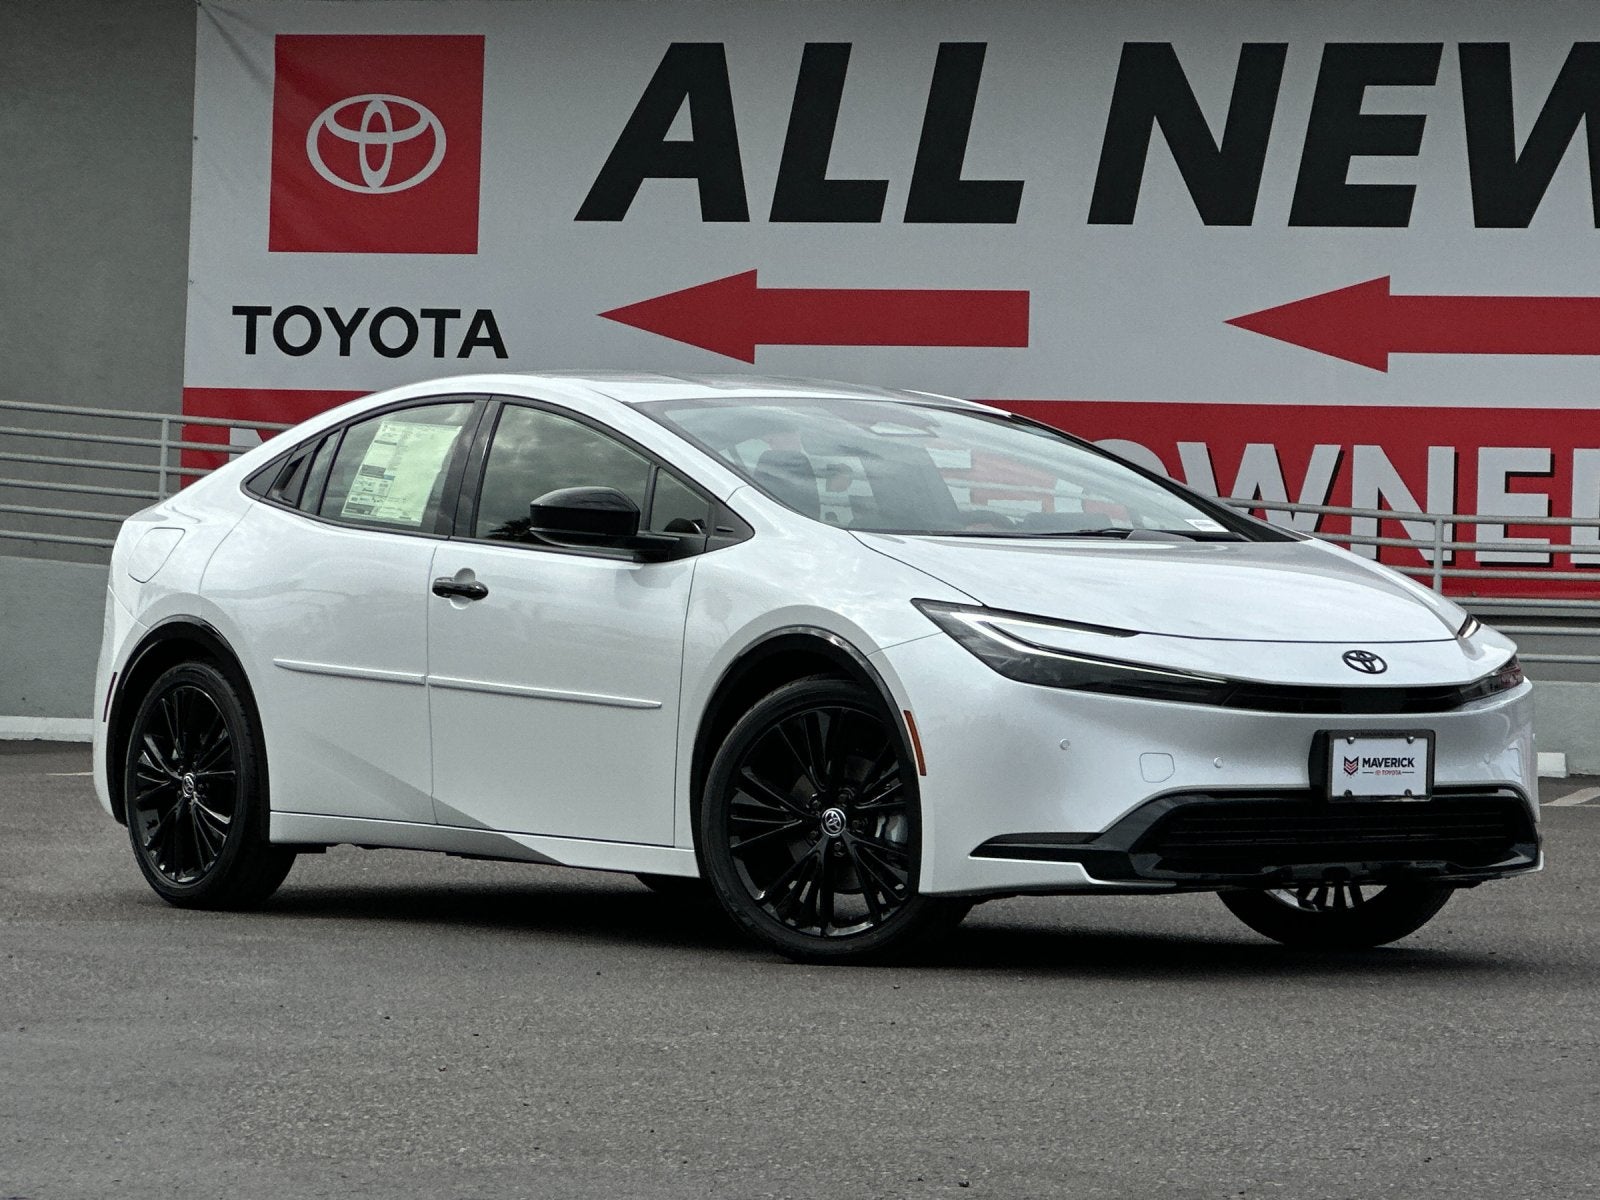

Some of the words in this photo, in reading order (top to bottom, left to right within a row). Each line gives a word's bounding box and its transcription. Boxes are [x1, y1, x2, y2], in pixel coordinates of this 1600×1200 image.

[574, 42, 1024, 224] ALL
[1087, 41, 1600, 228] NEW
[232, 305, 509, 359] TOYOTA
[1362, 757, 1415, 768] MAVERICK
